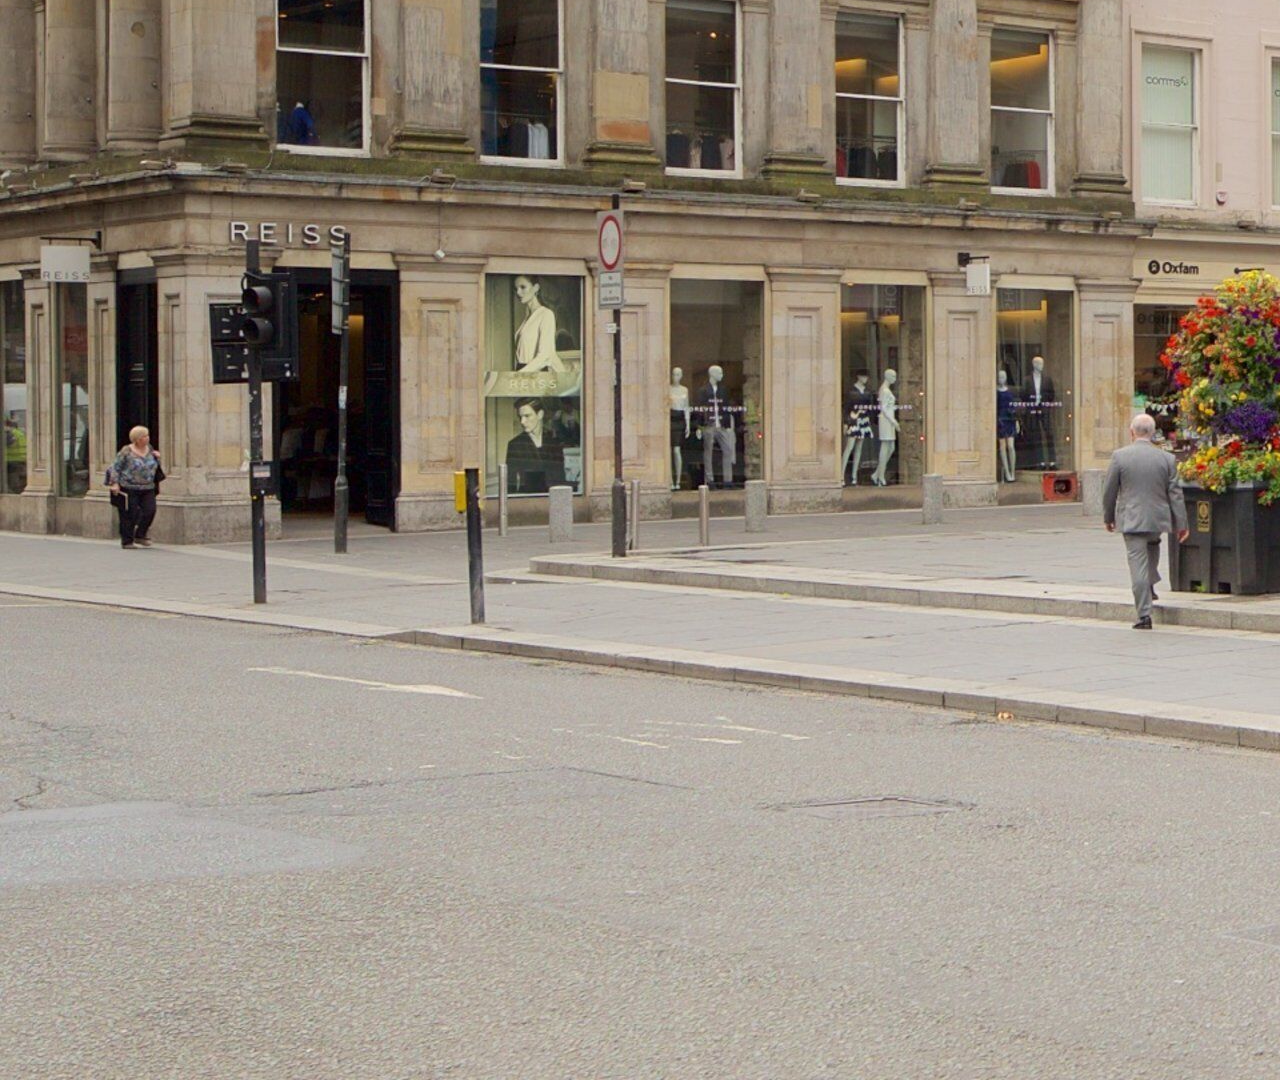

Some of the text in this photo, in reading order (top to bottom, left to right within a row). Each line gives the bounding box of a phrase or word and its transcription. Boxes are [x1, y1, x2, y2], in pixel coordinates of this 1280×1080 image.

[229, 221, 346, 245] REISS
[1162, 261, 1200, 275] Oxfam
[42, 270, 90, 281] REISS
